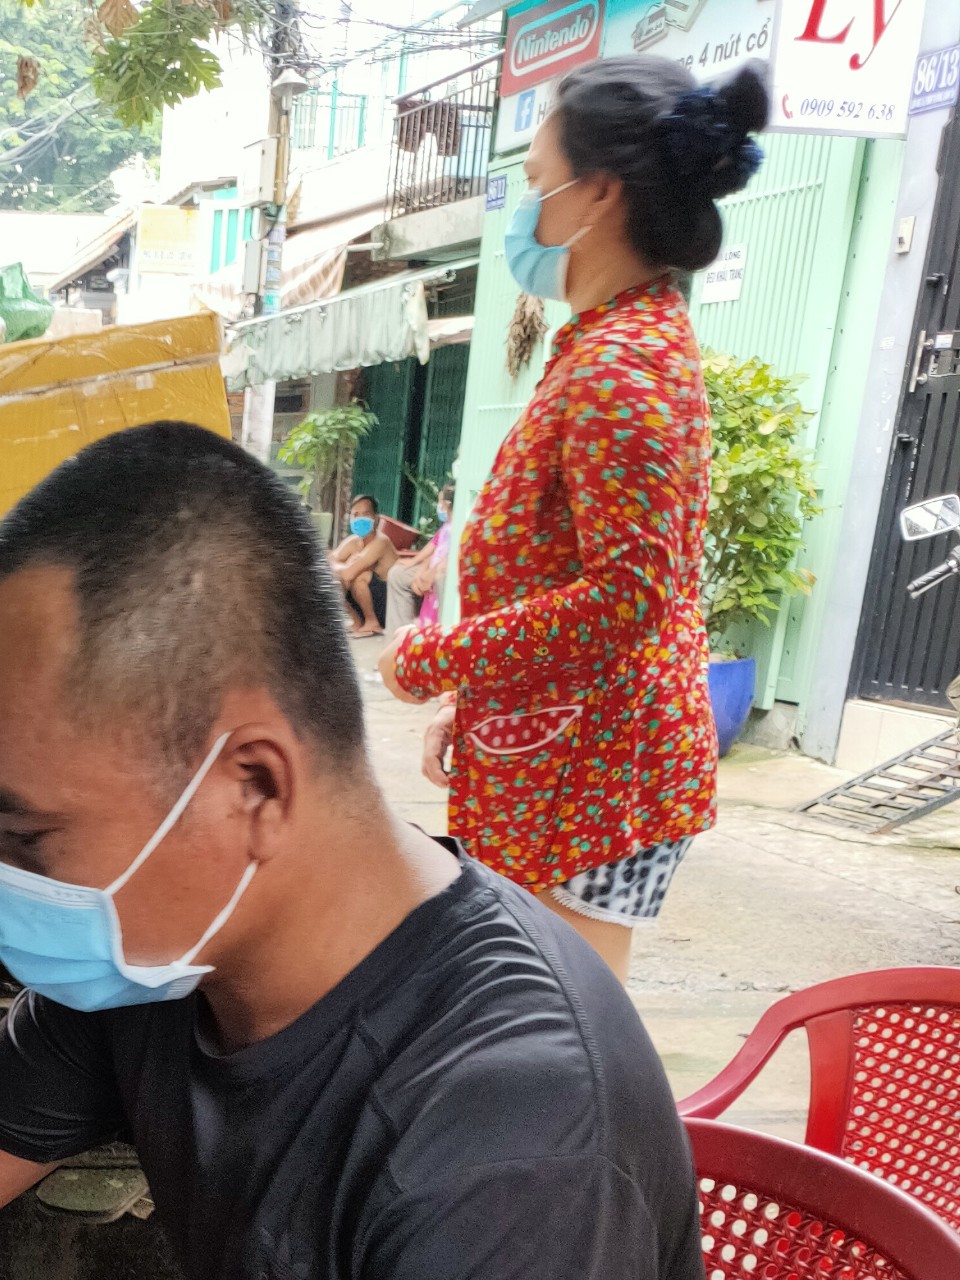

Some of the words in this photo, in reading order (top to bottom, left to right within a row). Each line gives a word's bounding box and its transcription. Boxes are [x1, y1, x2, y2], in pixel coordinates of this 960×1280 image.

[517, 13, 591, 64] Nintendo
[698, 42, 709, 67] 4
[713, 32, 742, 64] nút
[914, 49, 960, 96] 86/13
[800, 98, 835, 117] 0909
[837, 101, 864, 119] 592
[868, 103, 895, 121] 638
